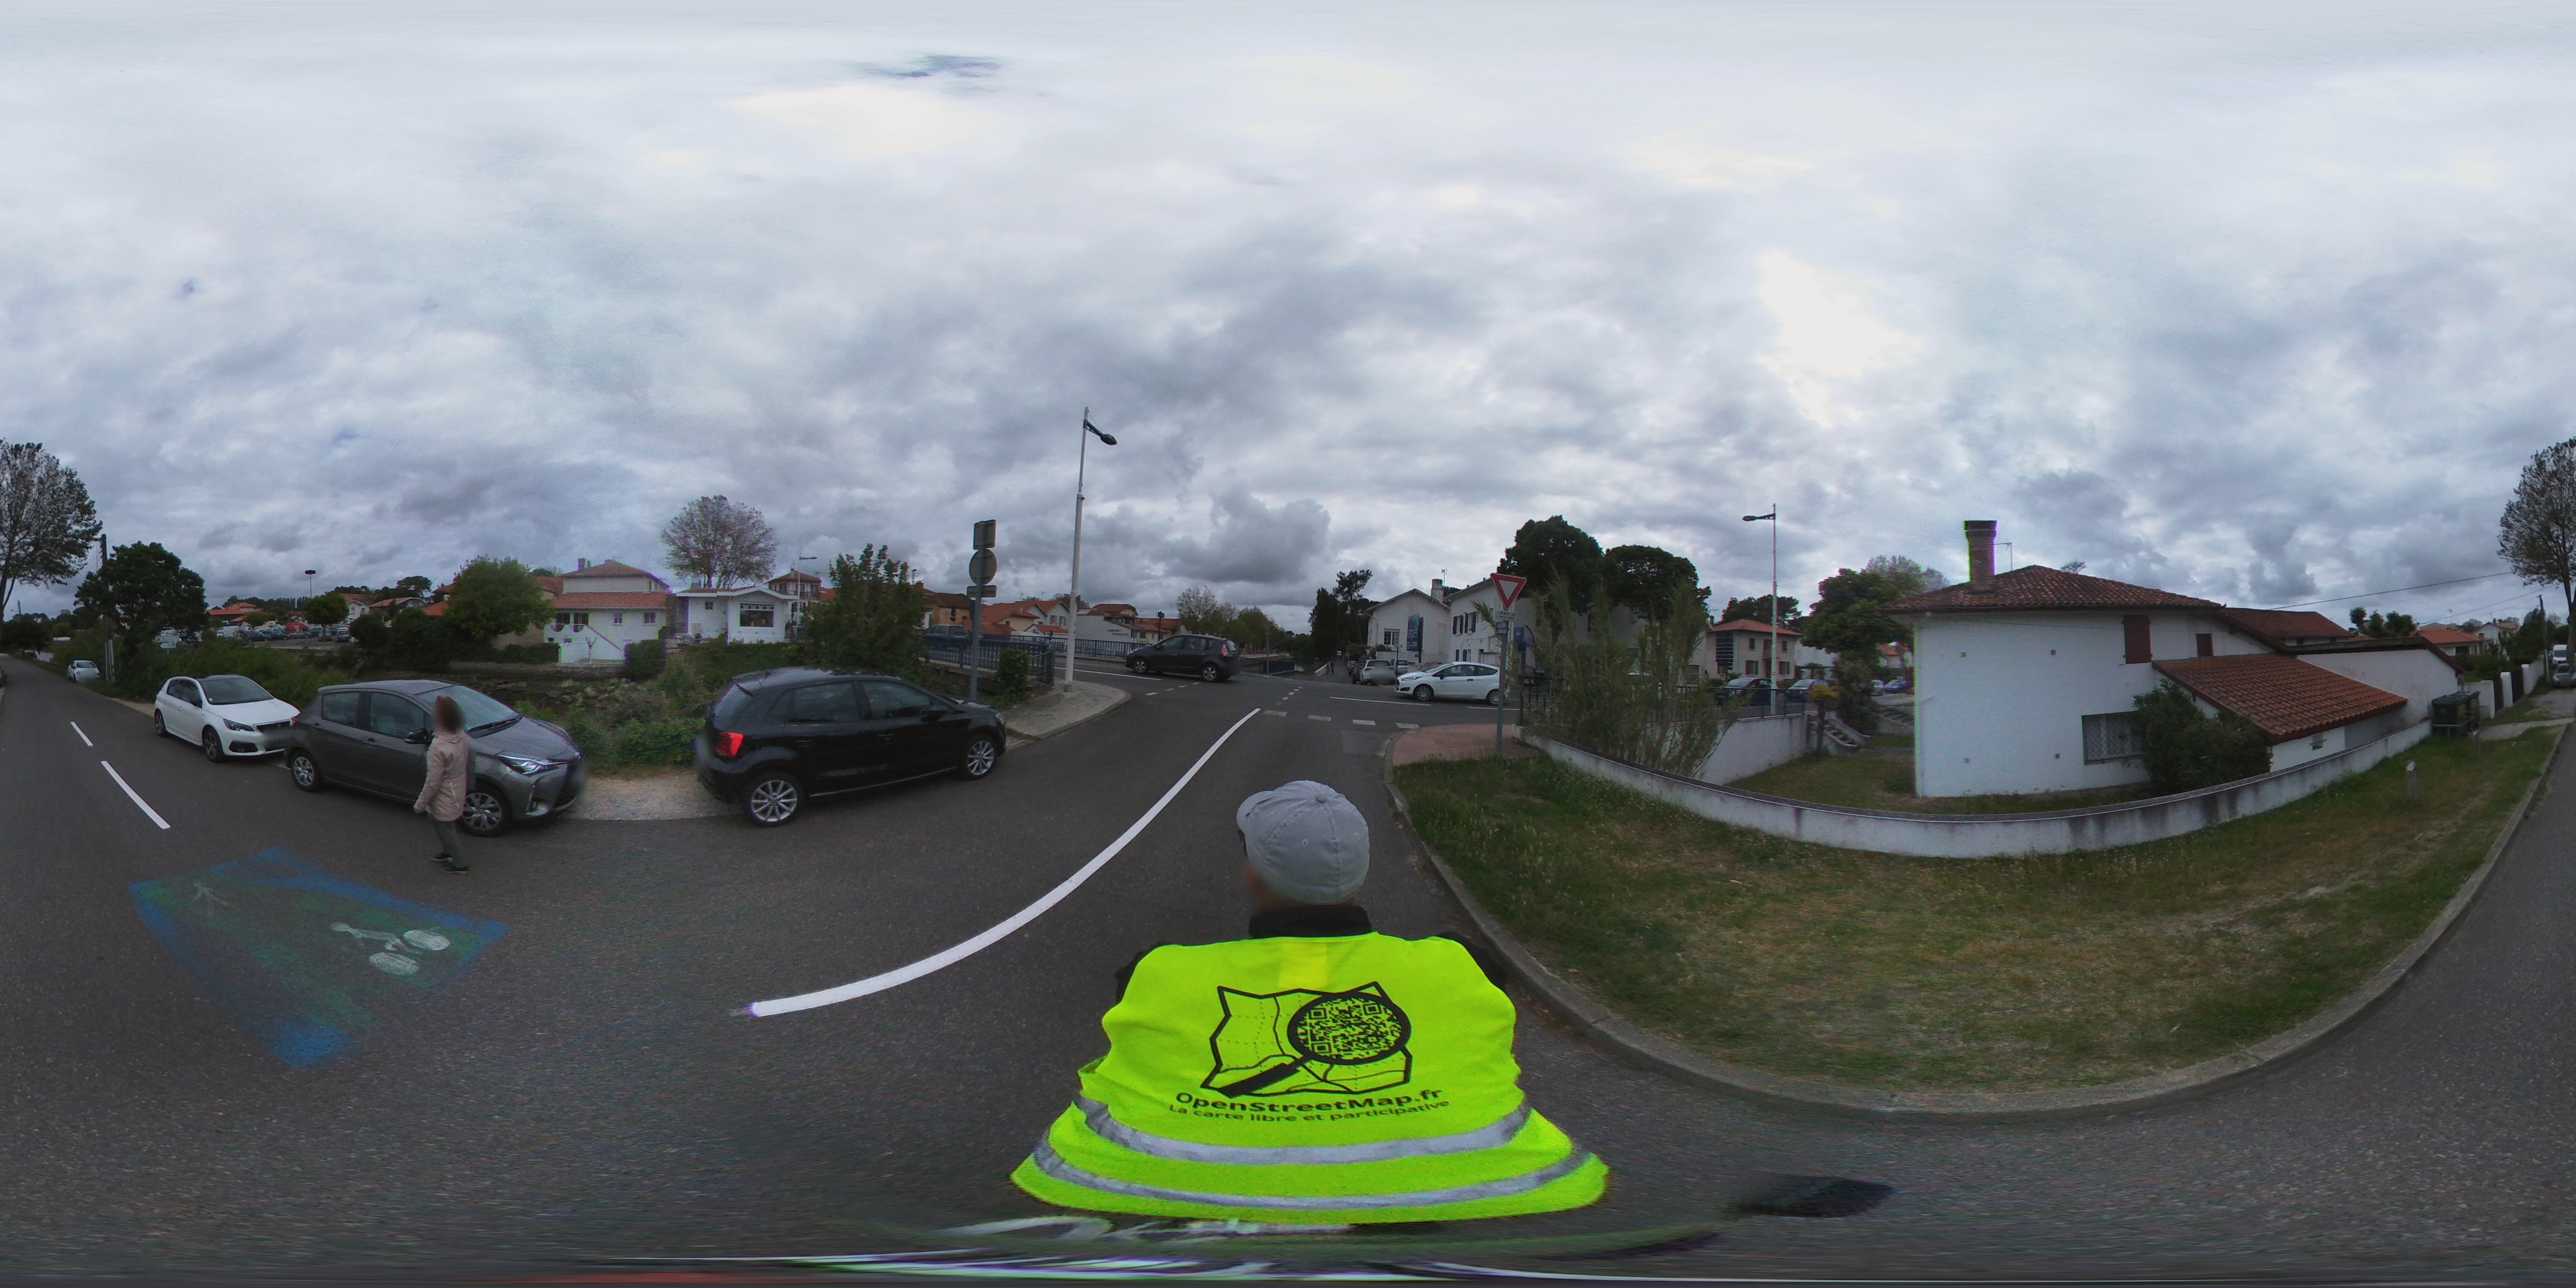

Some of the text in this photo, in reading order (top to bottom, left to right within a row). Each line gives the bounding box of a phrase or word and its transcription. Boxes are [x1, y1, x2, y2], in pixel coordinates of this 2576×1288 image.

[1169, 1104, 1187, 1114] La
[1193, 1110, 1244, 1120] carte
[1330, 1100, 1450, 1121] participative
[1176, 1090, 1442, 1112] OpenStreetMap.fr
